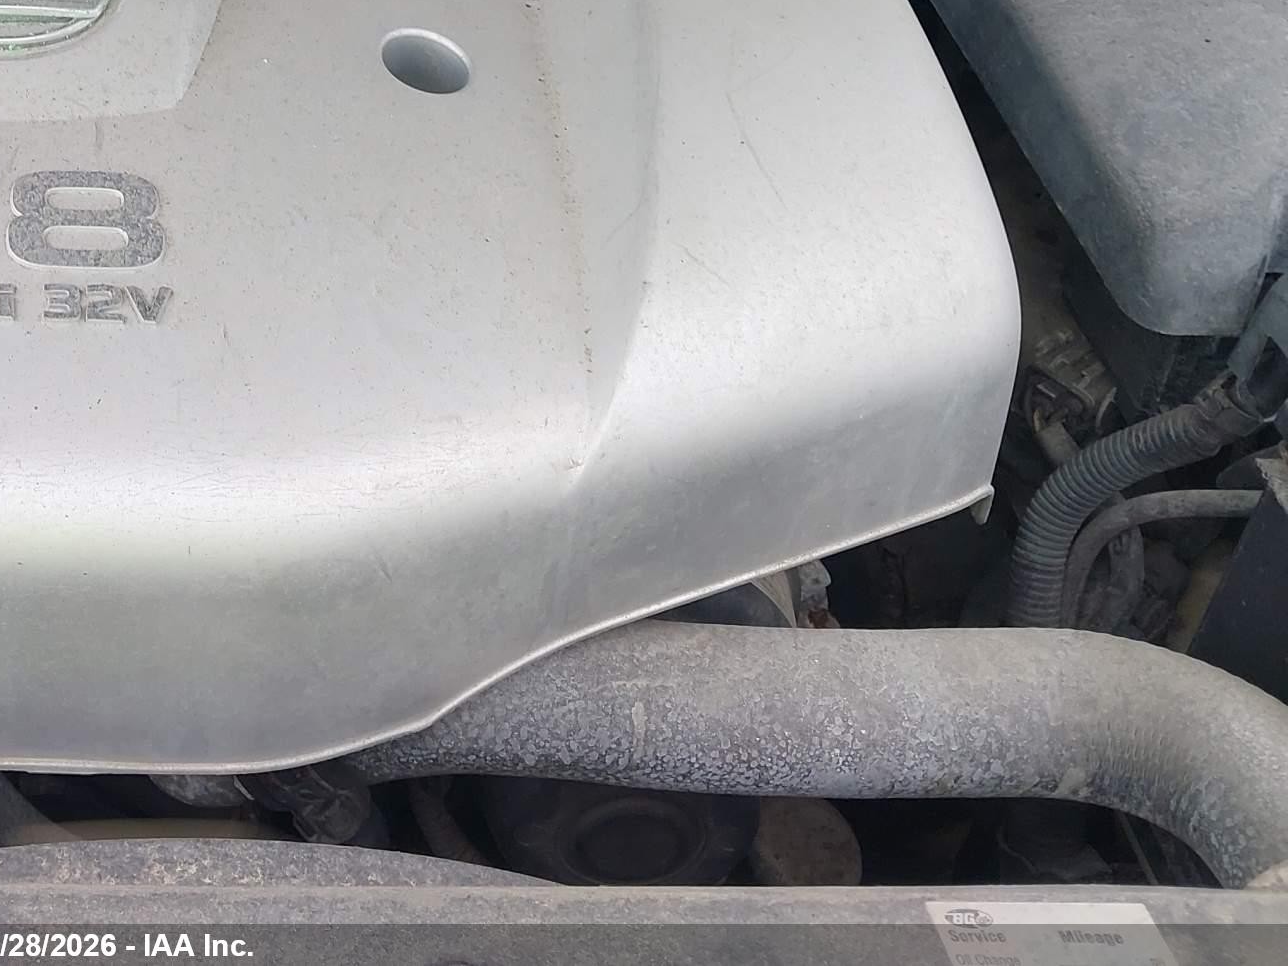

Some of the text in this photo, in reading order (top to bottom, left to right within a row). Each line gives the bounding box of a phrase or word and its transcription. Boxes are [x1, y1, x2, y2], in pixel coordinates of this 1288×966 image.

[42, 283, 174, 324] 32V
[948, 929, 1124, 946] Service Mileage
